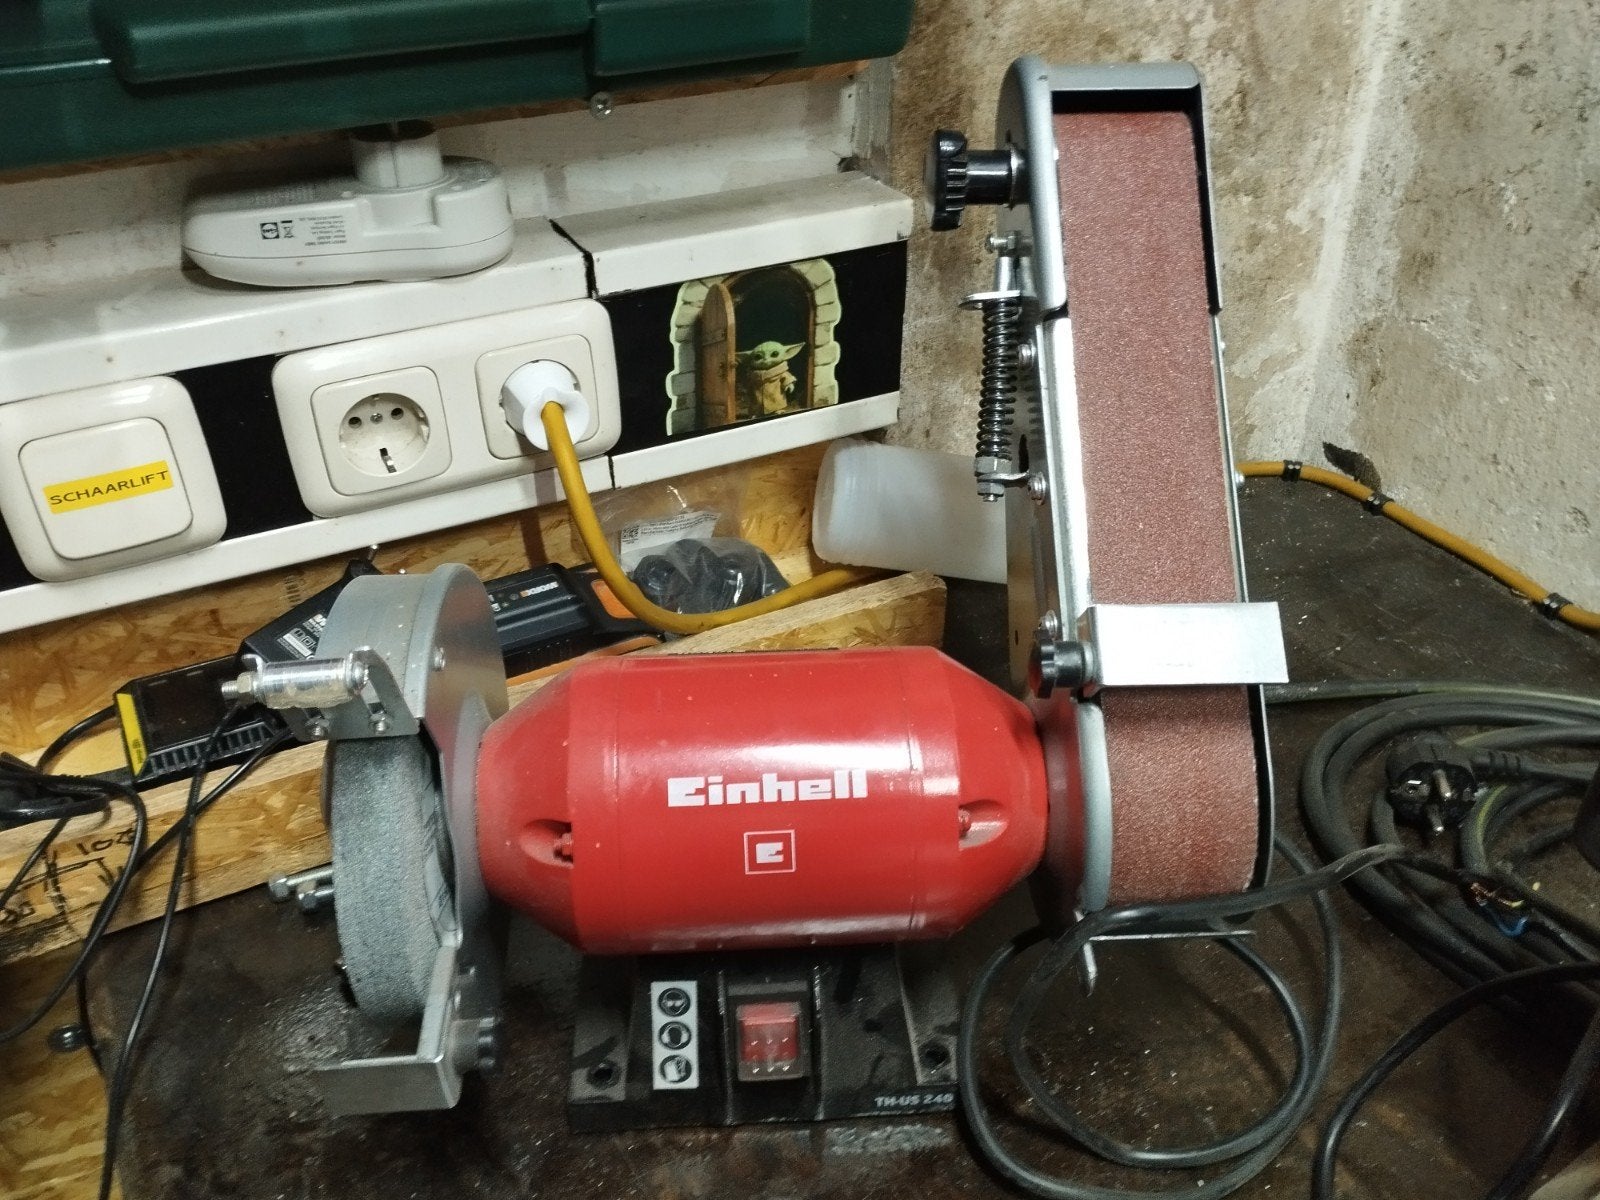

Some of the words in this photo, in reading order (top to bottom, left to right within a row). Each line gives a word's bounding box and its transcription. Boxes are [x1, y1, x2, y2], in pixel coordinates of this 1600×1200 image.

[49, 470, 169, 505] SCHAARLIFT
[667, 768, 868, 807] Einhell
[874, 1095, 920, 1107] TH-US
[922, 1093, 954, 1104] 240
